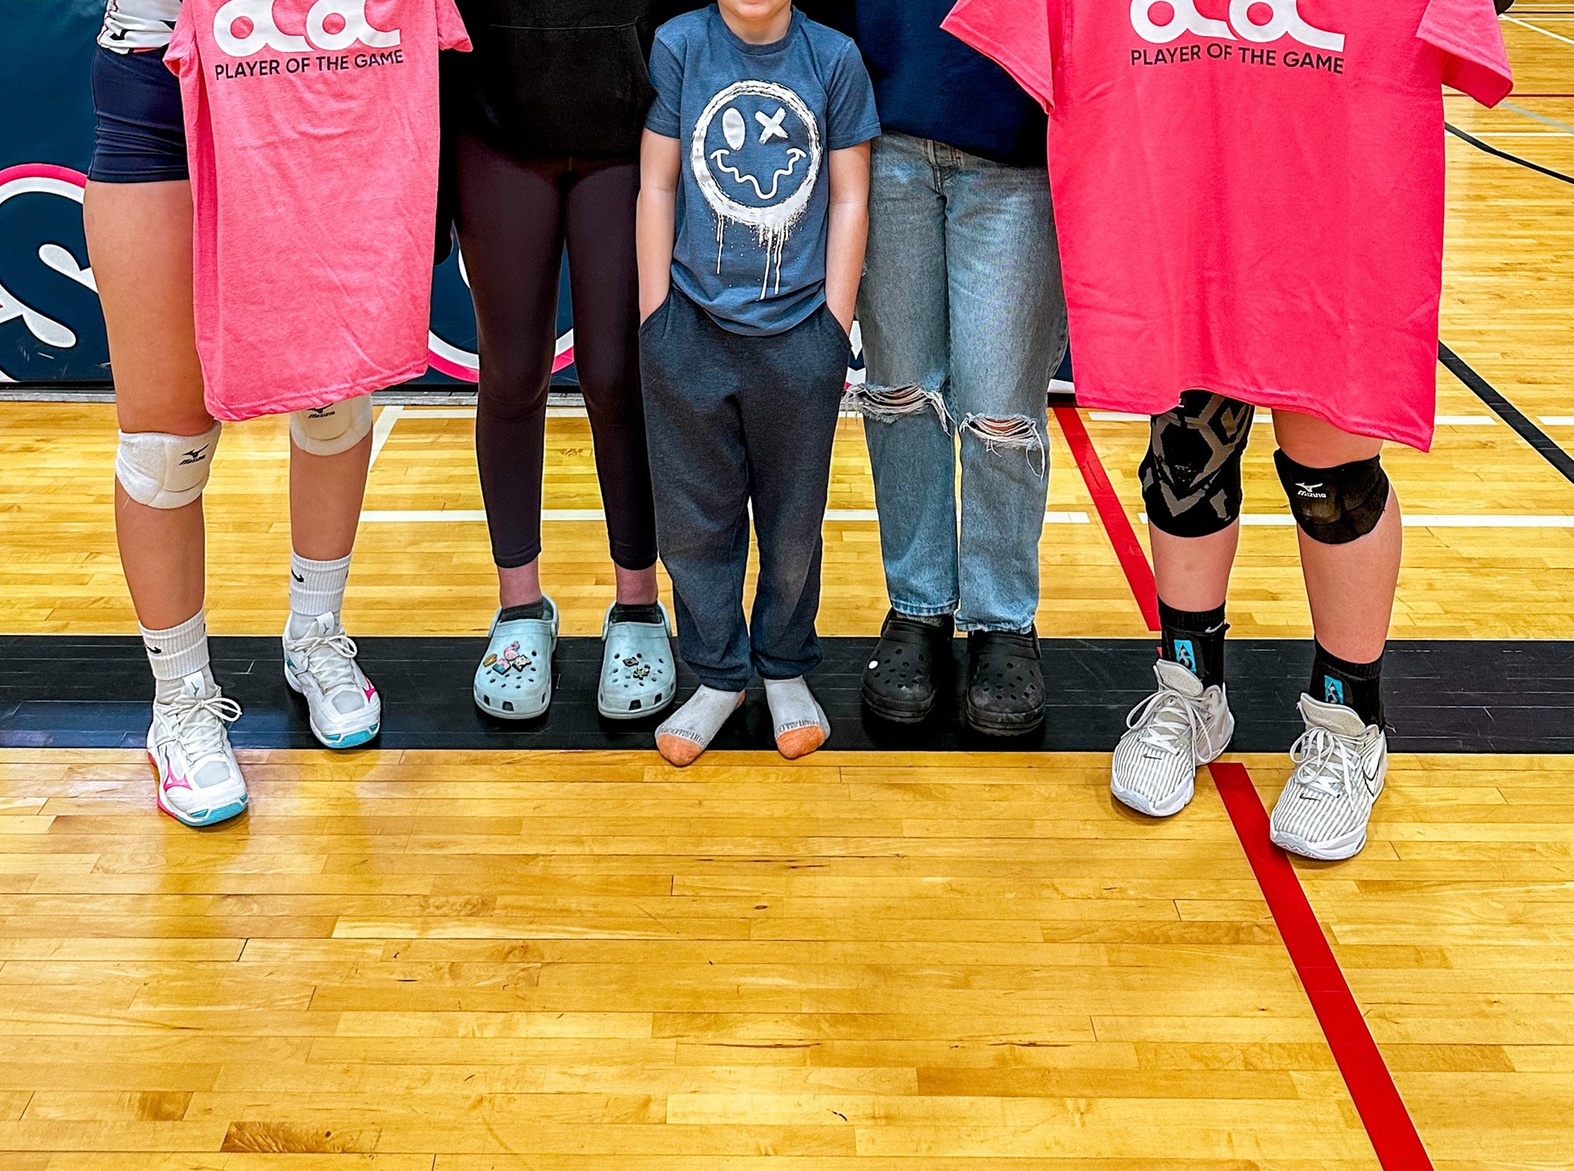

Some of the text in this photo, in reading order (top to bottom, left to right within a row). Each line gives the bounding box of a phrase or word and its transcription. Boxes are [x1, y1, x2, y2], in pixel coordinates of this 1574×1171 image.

[214, 48, 404, 81] PLAYER OF THE GAME
[1131, 43, 1345, 75] PLAYER OF THE GAME
